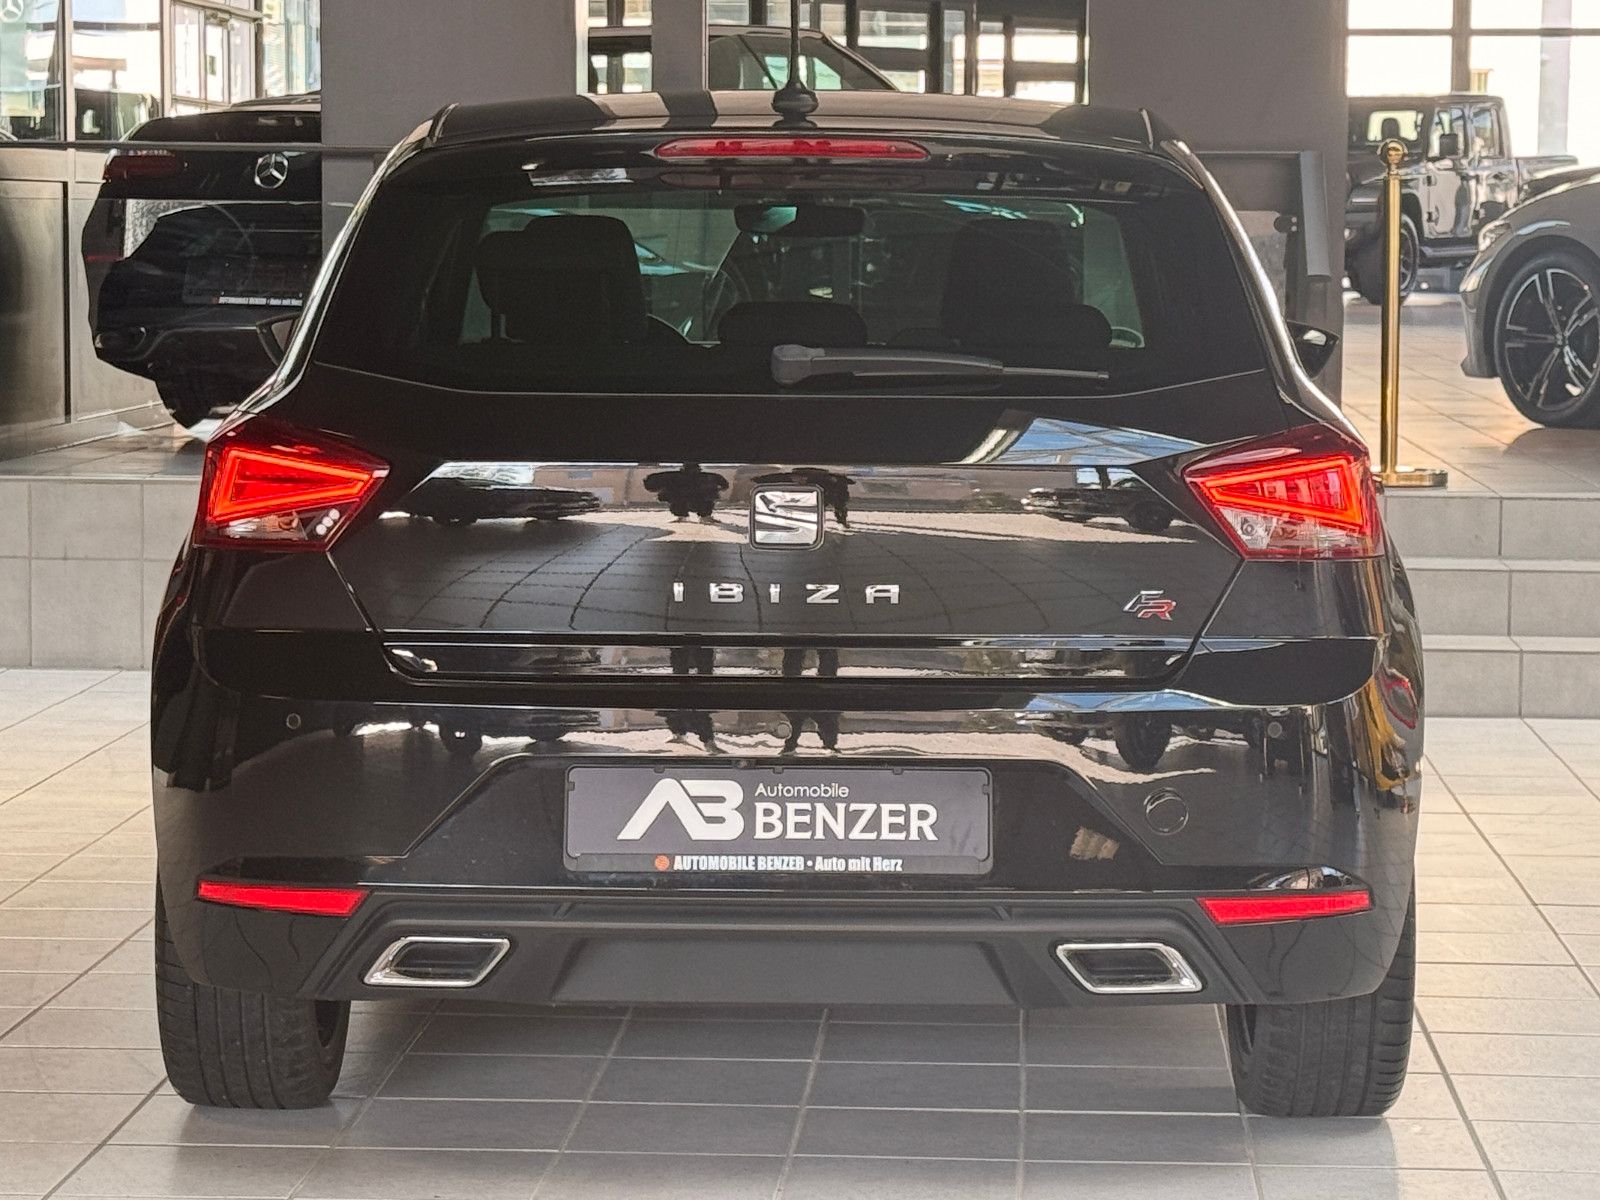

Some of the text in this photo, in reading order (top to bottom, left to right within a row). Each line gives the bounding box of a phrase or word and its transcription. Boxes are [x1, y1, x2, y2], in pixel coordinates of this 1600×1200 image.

[673, 582, 900, 604] IBIZA
[1122, 590, 1177, 621] FR
[754, 782, 850, 798] Automobile
[753, 801, 939, 841] BENZER
[673, 855, 903, 872] AUTOMOBILE BENZER Auto mit Herz
